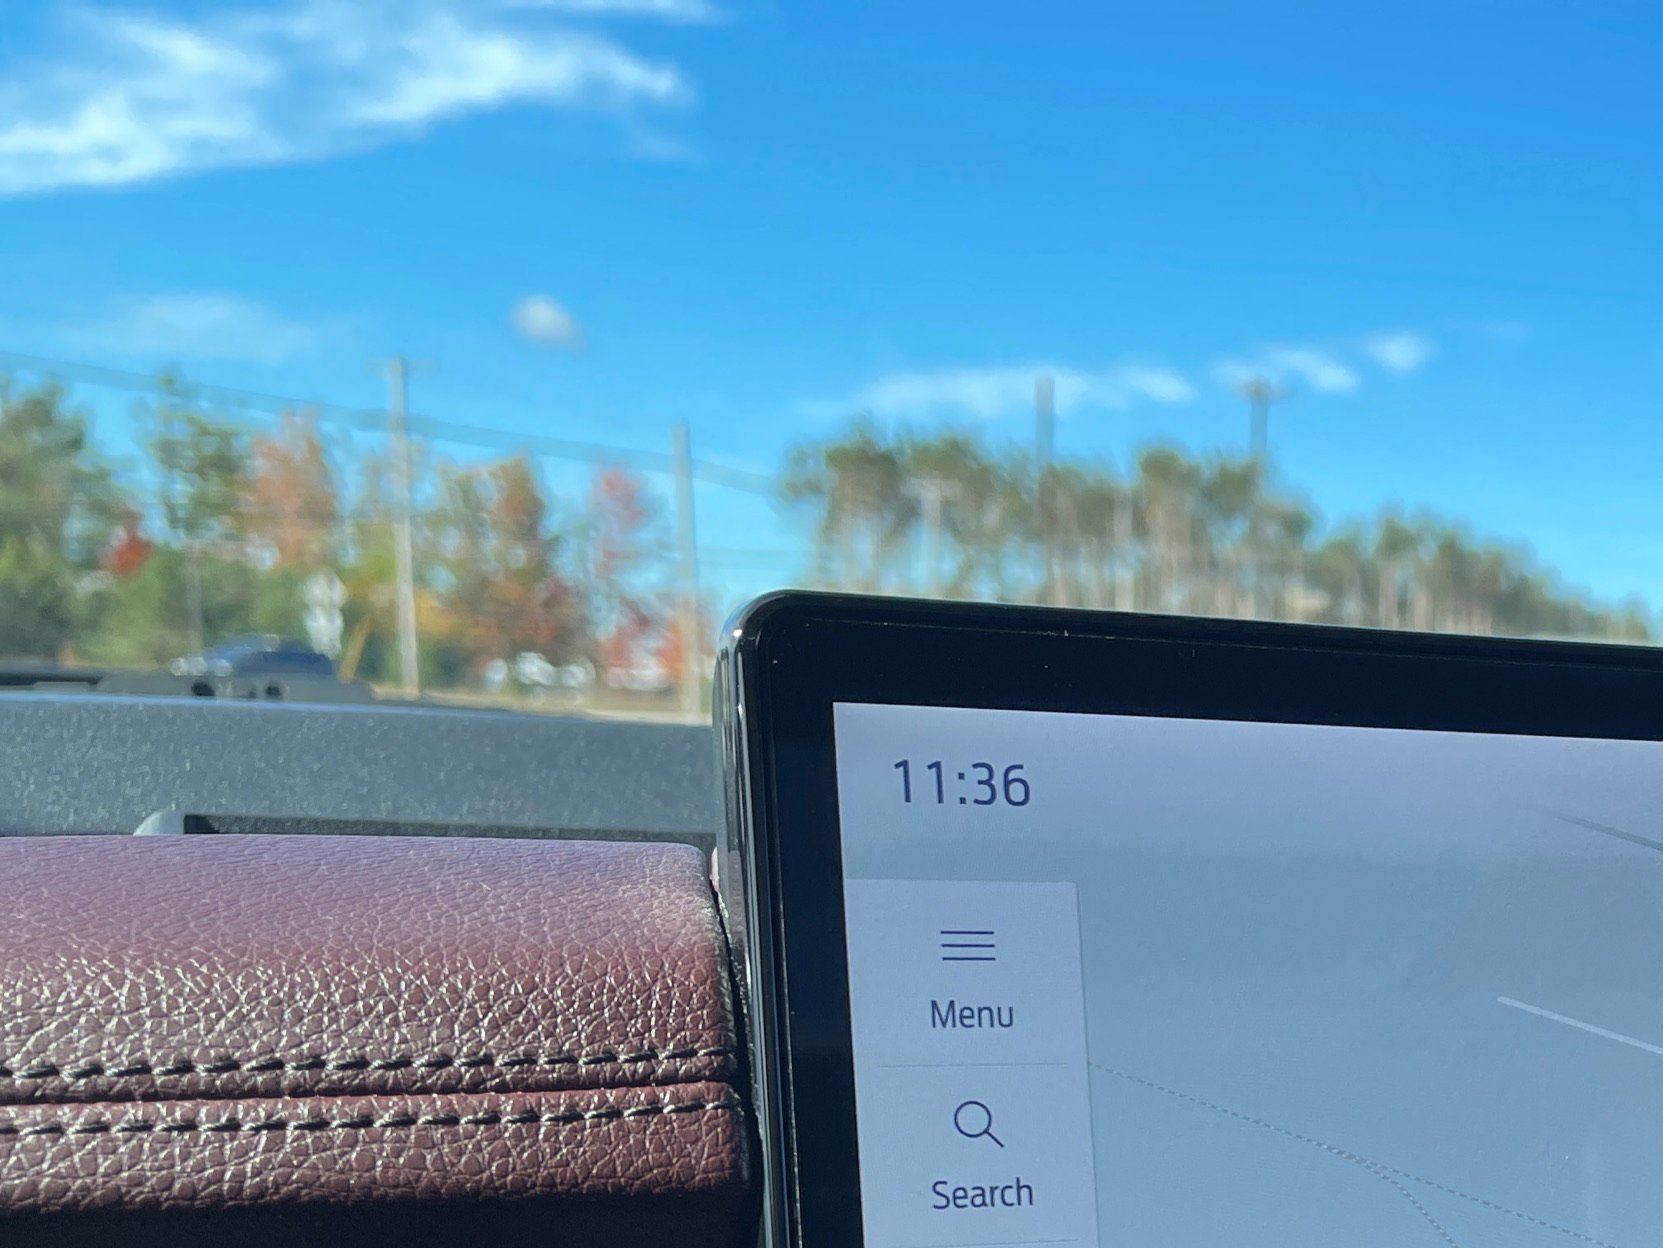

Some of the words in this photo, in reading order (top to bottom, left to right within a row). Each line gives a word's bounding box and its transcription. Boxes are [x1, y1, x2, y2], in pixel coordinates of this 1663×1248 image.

[894, 760, 1030, 806] 11:36
[930, 1000, 1014, 1028] Menu
[932, 1177, 1034, 1209] Search
